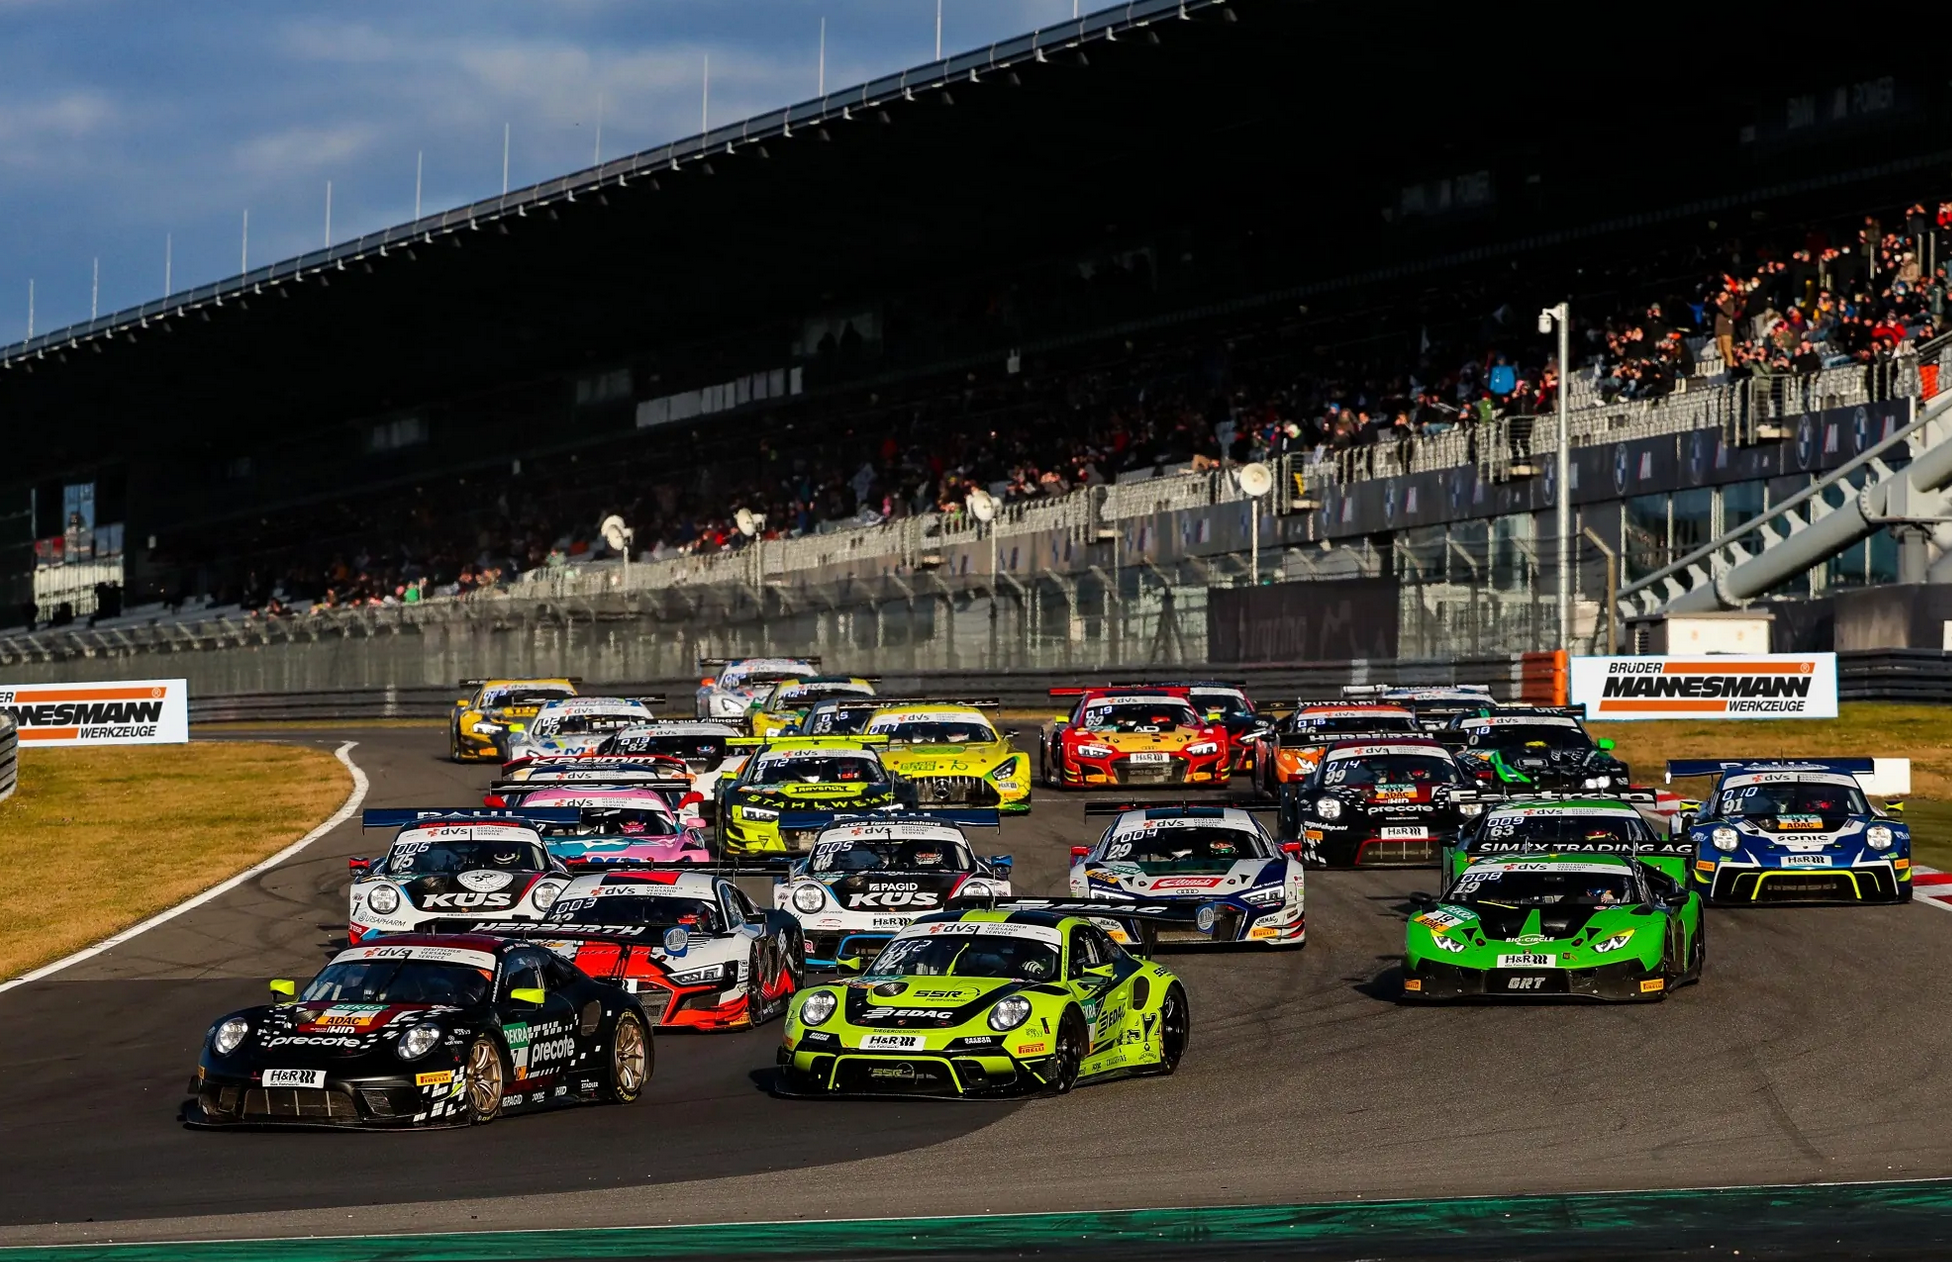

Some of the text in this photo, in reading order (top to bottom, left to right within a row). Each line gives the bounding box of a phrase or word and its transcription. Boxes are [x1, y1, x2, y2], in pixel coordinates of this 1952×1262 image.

[1608, 661, 1662, 674] BRÜDER
[1602, 676, 1812, 698] MANNESMANN
[574, 707, 594, 715] dvs
[1728, 700, 1806, 712] WERKZEUGE
[907, 713, 930, 721] dvs
[80, 725, 157, 739] WERKZEUGE
[813, 721, 832, 734] 33
[627, 743, 647, 752] 82
[567, 772, 592, 780] dvs
[1324, 769, 1347, 785] 99
[1765, 774, 1791, 783] dvs
[567, 798, 594, 807] dvs
[1723, 798, 1744, 814] 91
[1367, 804, 1434, 816] precote
[1156, 818, 1185, 828] dvs
[440, 828, 468, 836] dvs
[865, 826, 893, 835] dvs
[1387, 828, 1409, 836] H&R
[1491, 825, 1515, 837] 63
[1106, 842, 1133, 860] 29
[1659, 843, 1694, 853] AG
[1787, 856, 1811, 864] H&R
[1517, 863, 1548, 871] dvs
[605, 884, 636, 896] dvs
[881, 882, 919, 892] PAGID
[1453, 881, 1481, 894] 19
[422, 892, 513, 909] KÜS
[848, 891, 939, 908] KÜS
[873, 918, 898, 927] H&R
[1434, 913, 1455, 923] 19
[943, 922, 976, 935] dvs
[377, 947, 413, 959] dvs
[1504, 955, 1531, 964] H&R
[1507, 977, 1546, 989] GRT
[913, 989, 962, 999] SSR
[894, 1009, 954, 1019] EDAG
[325, 1016, 362, 1025] ADAC
[504, 1027, 528, 1044] DEKRA
[870, 1035, 900, 1045] H&R
[269, 1036, 361, 1048] precote
[531, 1035, 575, 1068] precote
[1018, 1043, 1045, 1054] PIRELLI
[270, 1070, 298, 1082] H&R
[419, 1073, 450, 1084] PIRELLI
